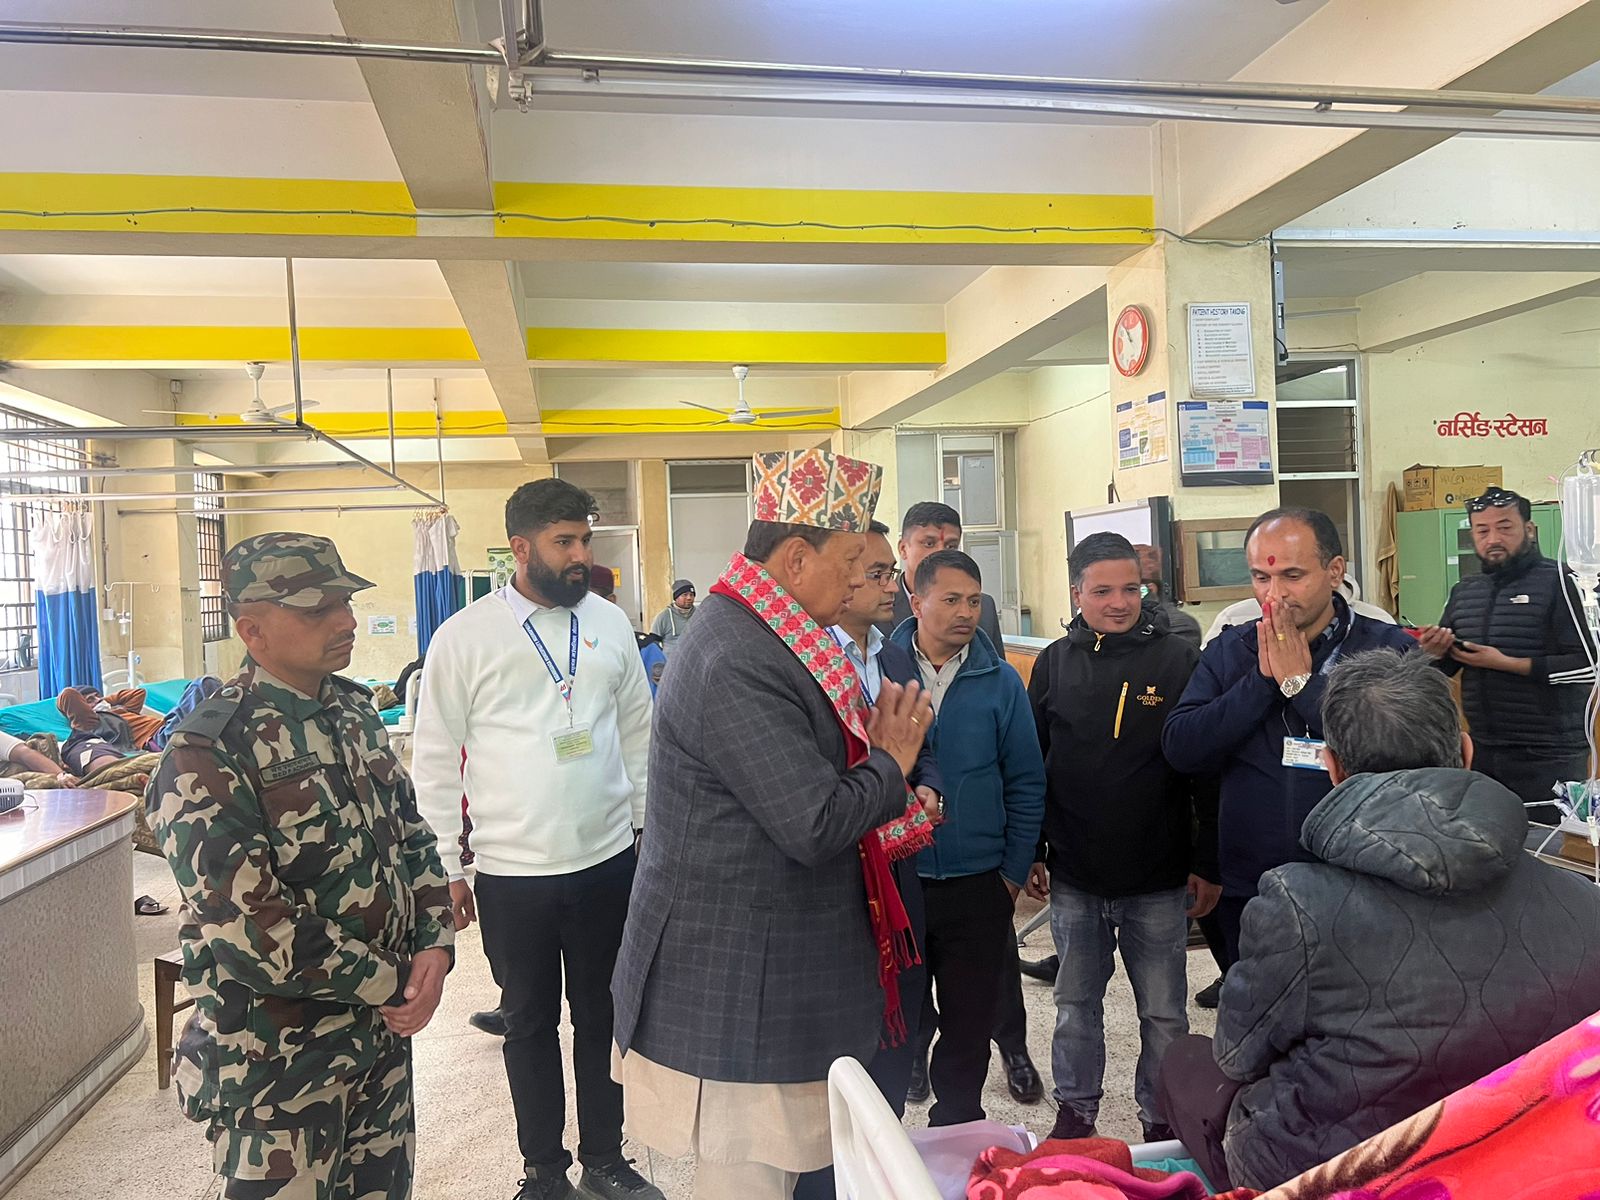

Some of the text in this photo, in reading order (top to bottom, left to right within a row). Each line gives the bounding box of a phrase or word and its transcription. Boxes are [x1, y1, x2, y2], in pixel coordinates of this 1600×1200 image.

[1192, 307, 1246, 316] PATIENT HISTORY TAKING
[1493, 413, 1548, 438] स्टेसन
[1136, 694, 1164, 703] GOLDEN
[1142, 699, 1157, 707] OAK
